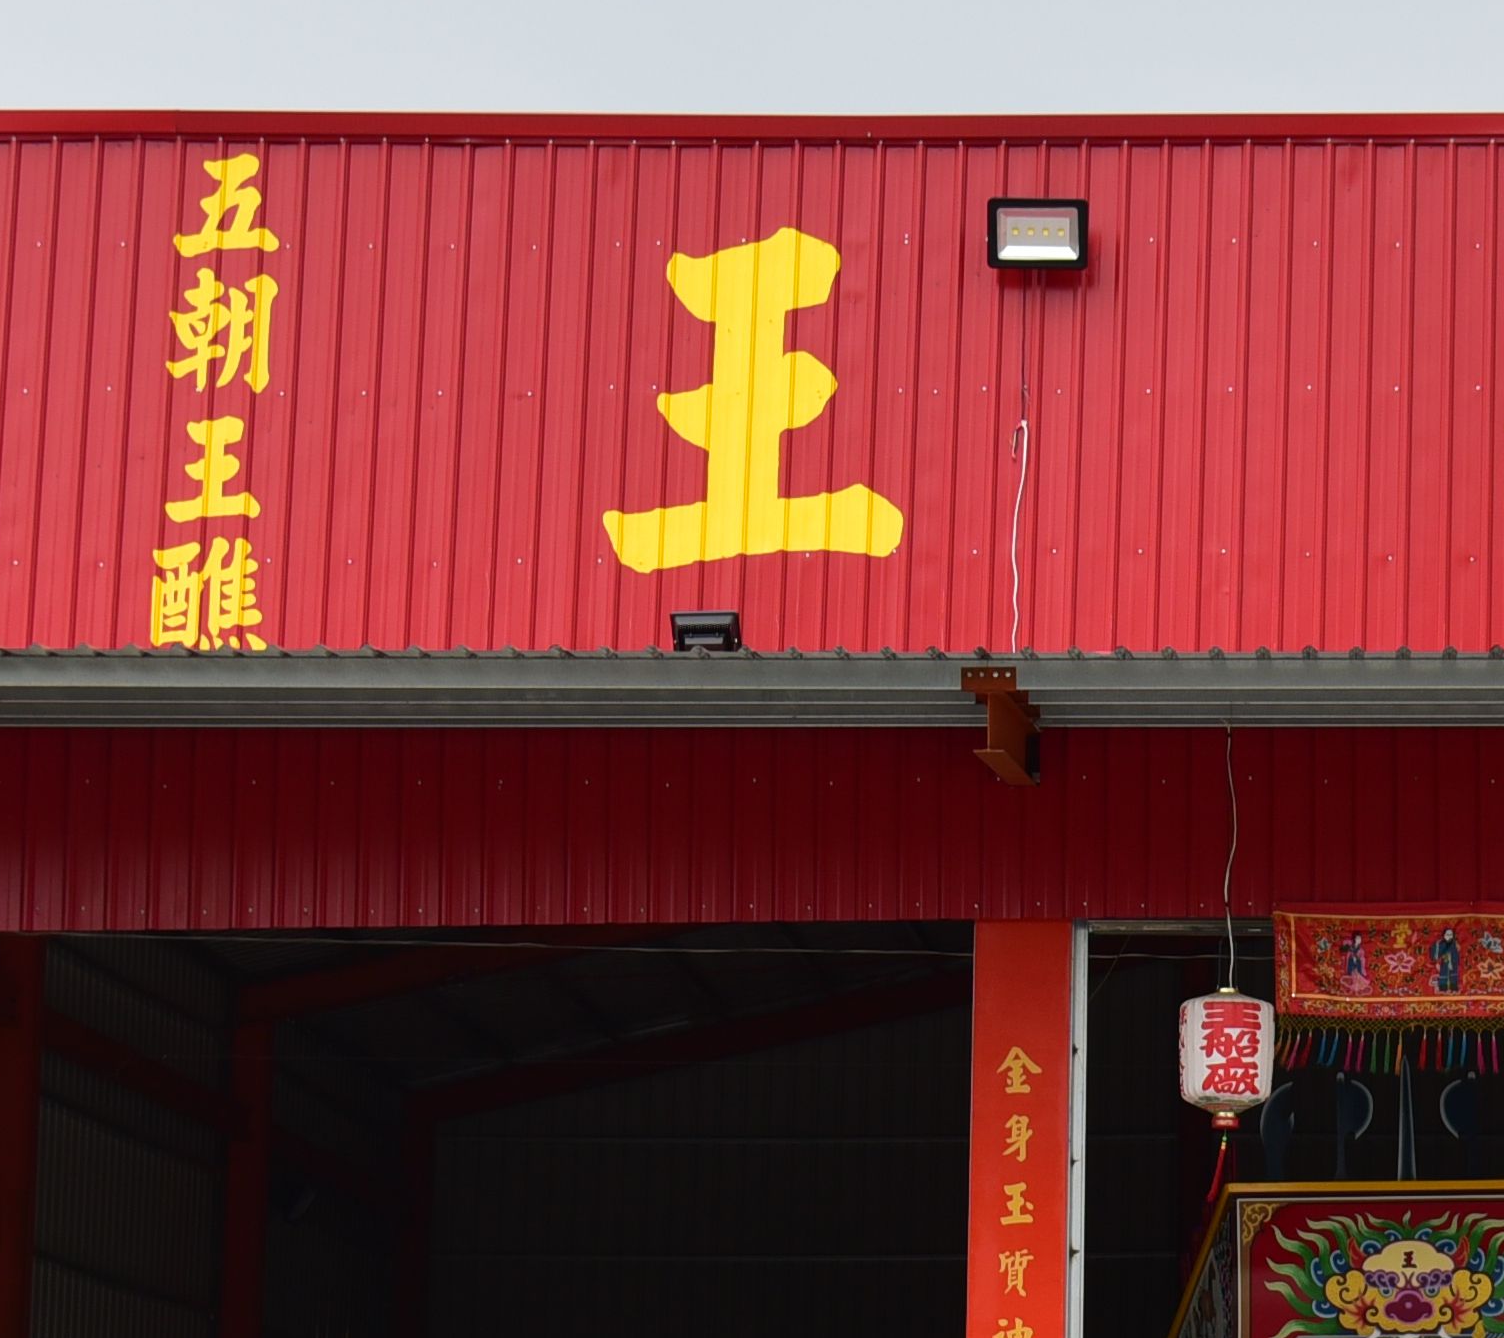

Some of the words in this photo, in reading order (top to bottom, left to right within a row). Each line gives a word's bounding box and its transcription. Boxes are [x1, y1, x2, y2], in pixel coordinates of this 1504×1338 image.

[150, 153, 267, 651] 五朝王醮
[1200, 1001, 1262, 1095] 王船廠
